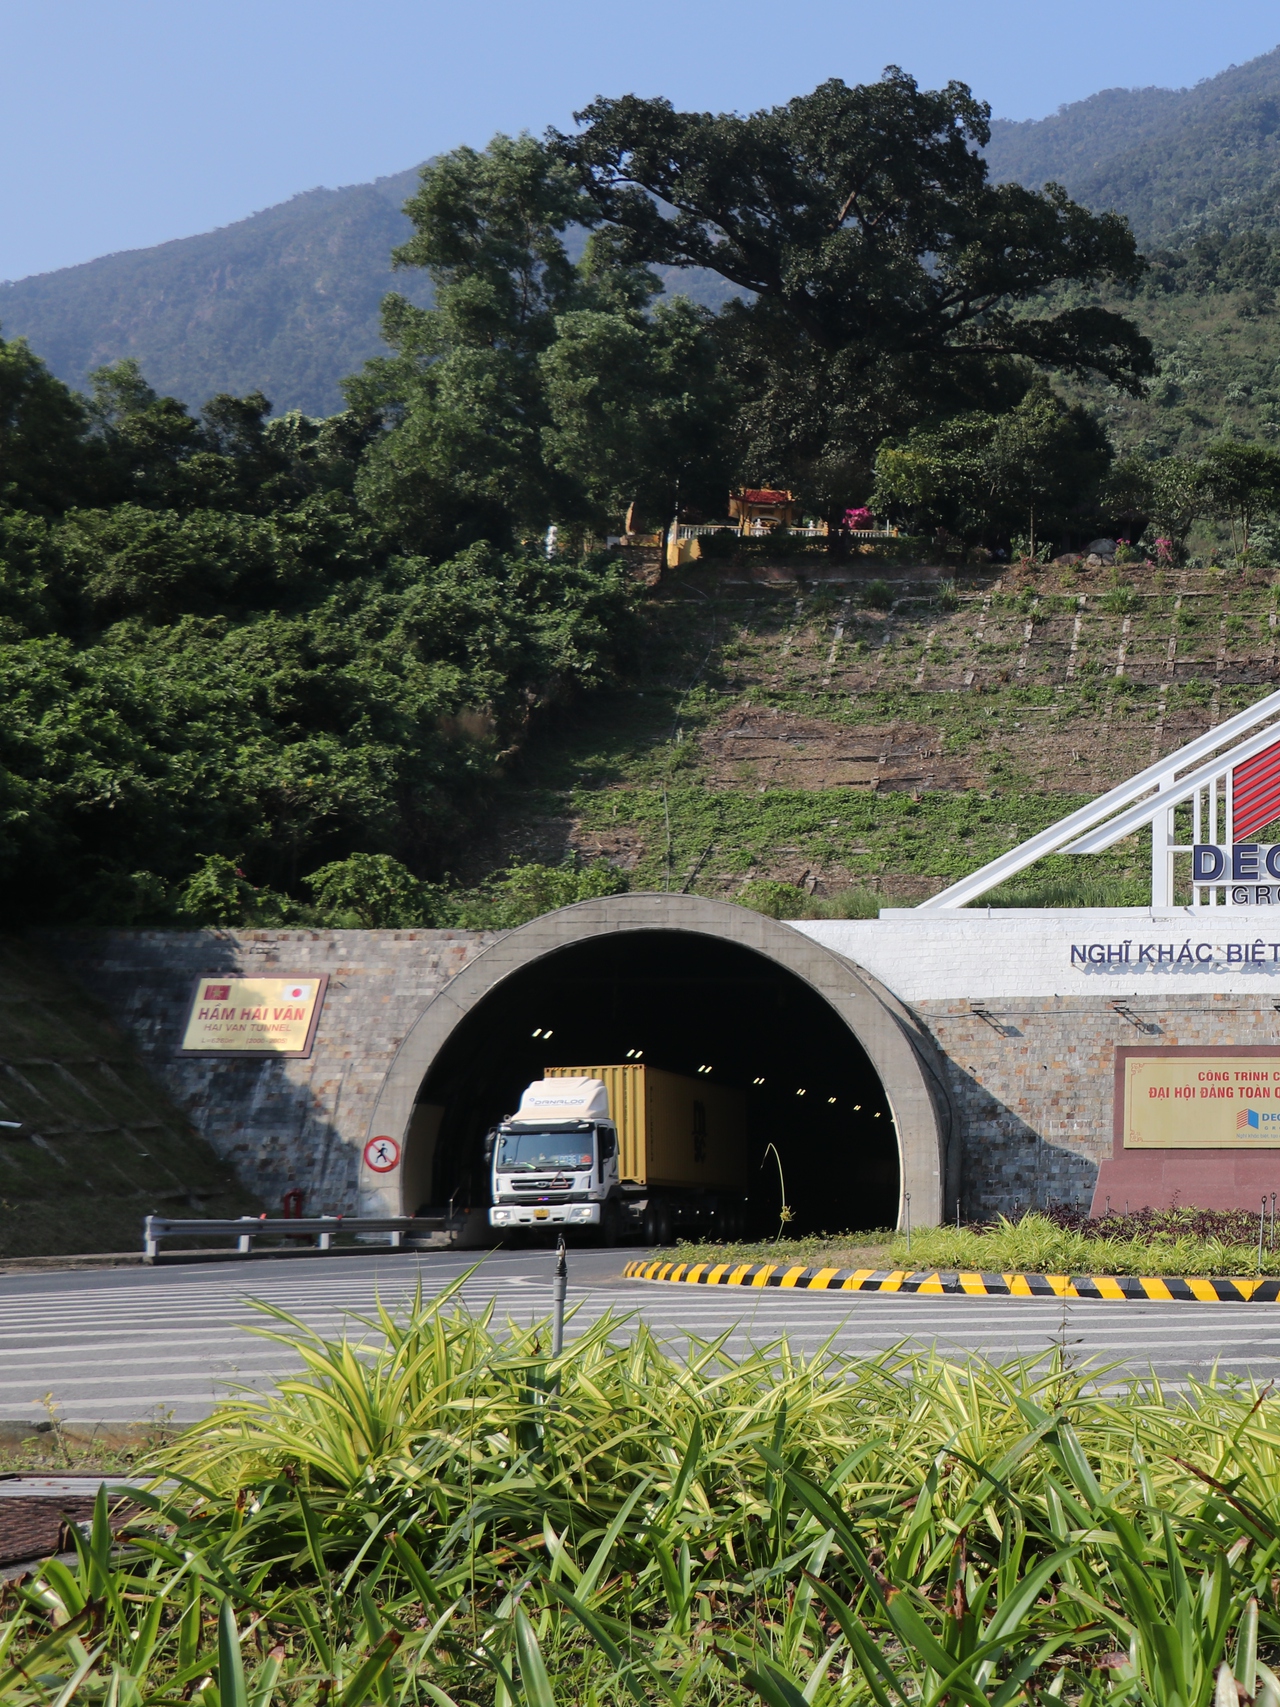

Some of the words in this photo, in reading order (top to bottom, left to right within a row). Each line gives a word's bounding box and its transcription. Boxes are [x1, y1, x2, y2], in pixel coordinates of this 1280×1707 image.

[1071, 940, 1132, 963] NGHĨ
[1138, 939, 1213, 963] KHÁC
[198, 1003, 236, 1021] HẦM
[239, 1004, 269, 1021] HẢI
[273, 1005, 306, 1021] VÂN
[203, 1023, 222, 1032] HAI
[225, 1023, 247, 1032] VAN
[250, 1024, 292, 1032] TUNNEL
[1197, 1070, 1230, 1082] CÔNG
[1234, 1070, 1269, 1081] TRÌNH
[1148, 1086, 1170, 1100] ĐẠI
[1174, 1084, 1196, 1101] HỘI
[1200, 1083, 1235, 1099] ĐẢNG
[1238, 1084, 1271, 1099] TOÀN
